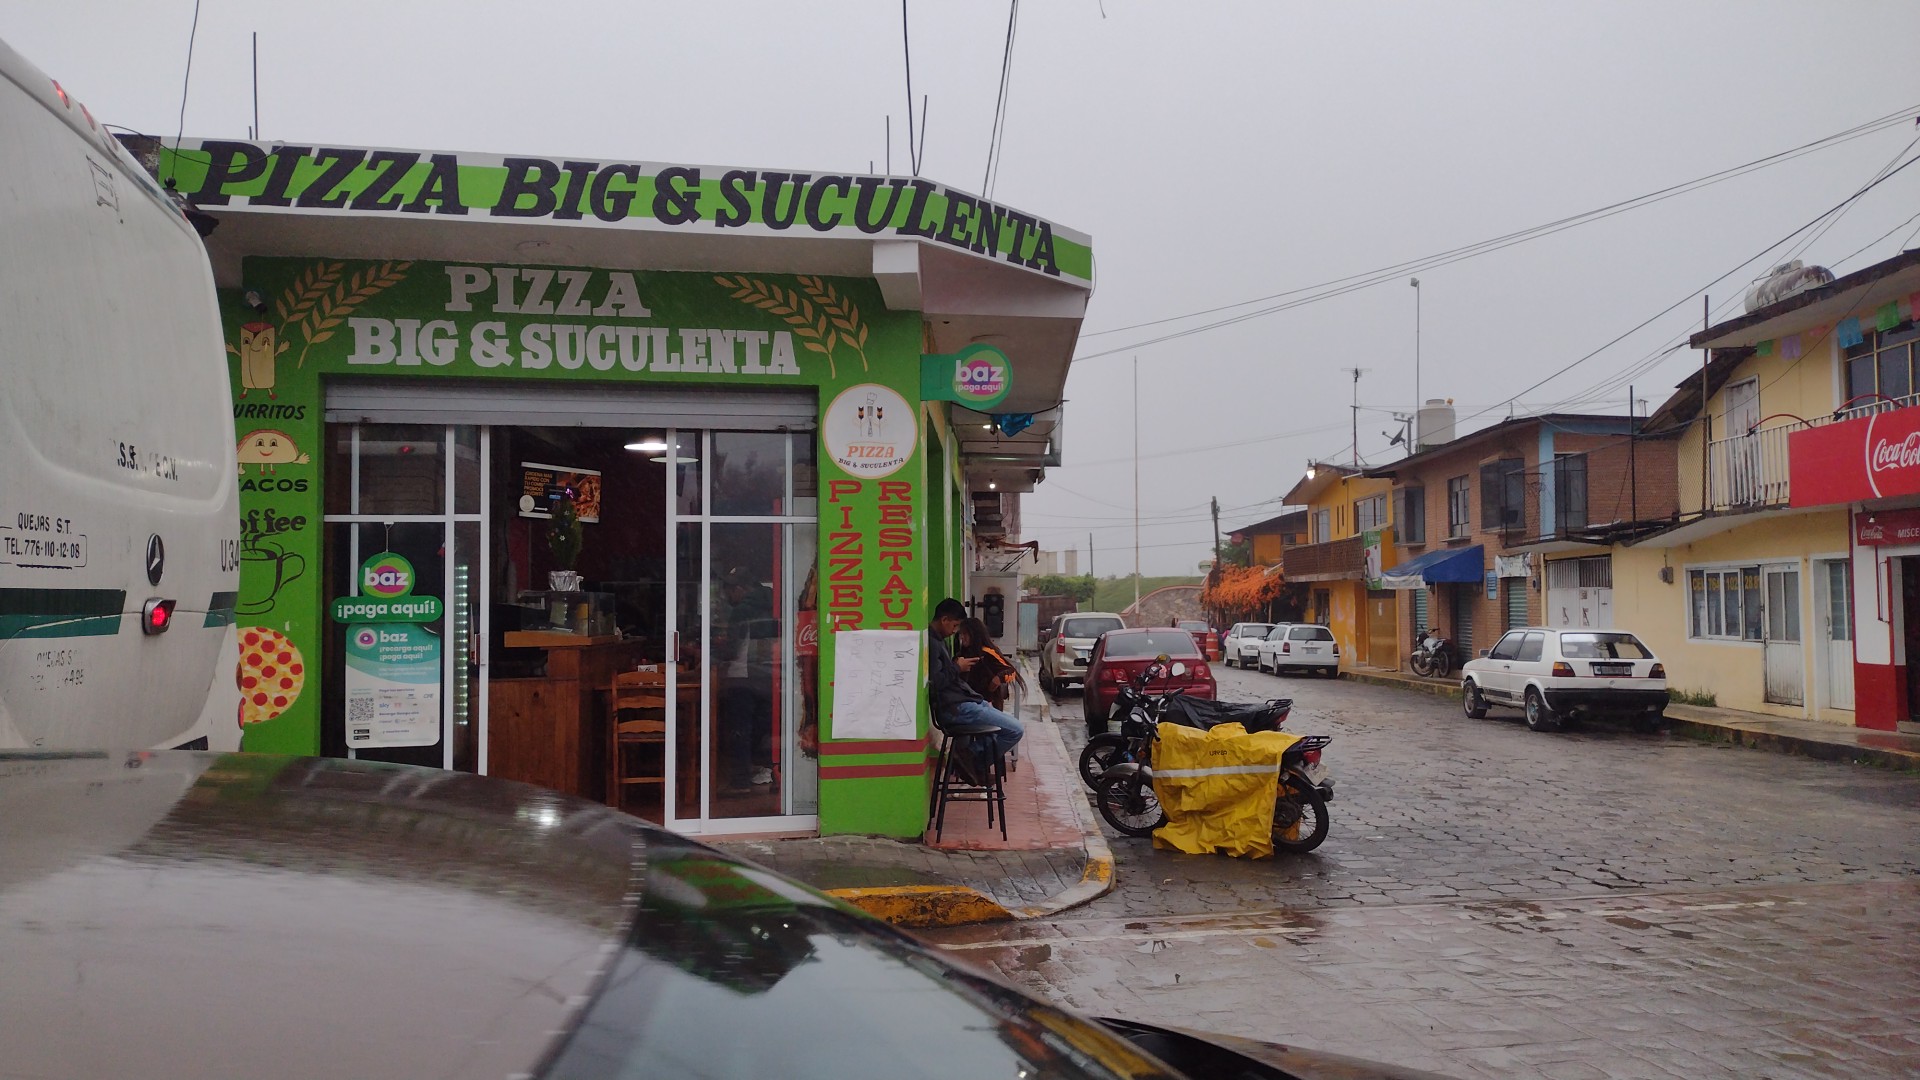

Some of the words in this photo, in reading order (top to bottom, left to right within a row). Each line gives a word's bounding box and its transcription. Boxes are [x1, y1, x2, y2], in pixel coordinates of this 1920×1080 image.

[190, 140, 469, 215] PIZZA
[490, 157, 641, 223] BIG
[652, 166, 703, 225] &
[714, 169, 1061, 276] SUCULENTA
[445, 265, 651, 318] PIZZA
[347, 317, 460, 367] BIG
[469, 321, 515, 368] &
[520, 323, 800, 375] SUCULENTA
[955, 359, 1003, 382] baz
[233, 403, 307, 420] URRITOS
[846, 446, 895, 458] PIZZA
[1872, 431, 1920, 472] Coca-Col
[838, 457, 851, 466] BIG
[860, 457, 905, 469] SUCULENTA
[239, 479, 308, 492] ACOS
[18, 512, 50, 532] QUEJAS
[56, 518, 72, 534] S.T.
[828, 480, 863, 634] PIZZER
[878, 481, 913, 631] RESTAU
[364, 567, 408, 586] baz
[337, 604, 388, 619] ¡paga
[391, 600, 435, 618] aquí!
[380, 631, 408, 642] baz
[894, 648, 914, 660] Ya
[885, 669, 912, 689] hay
